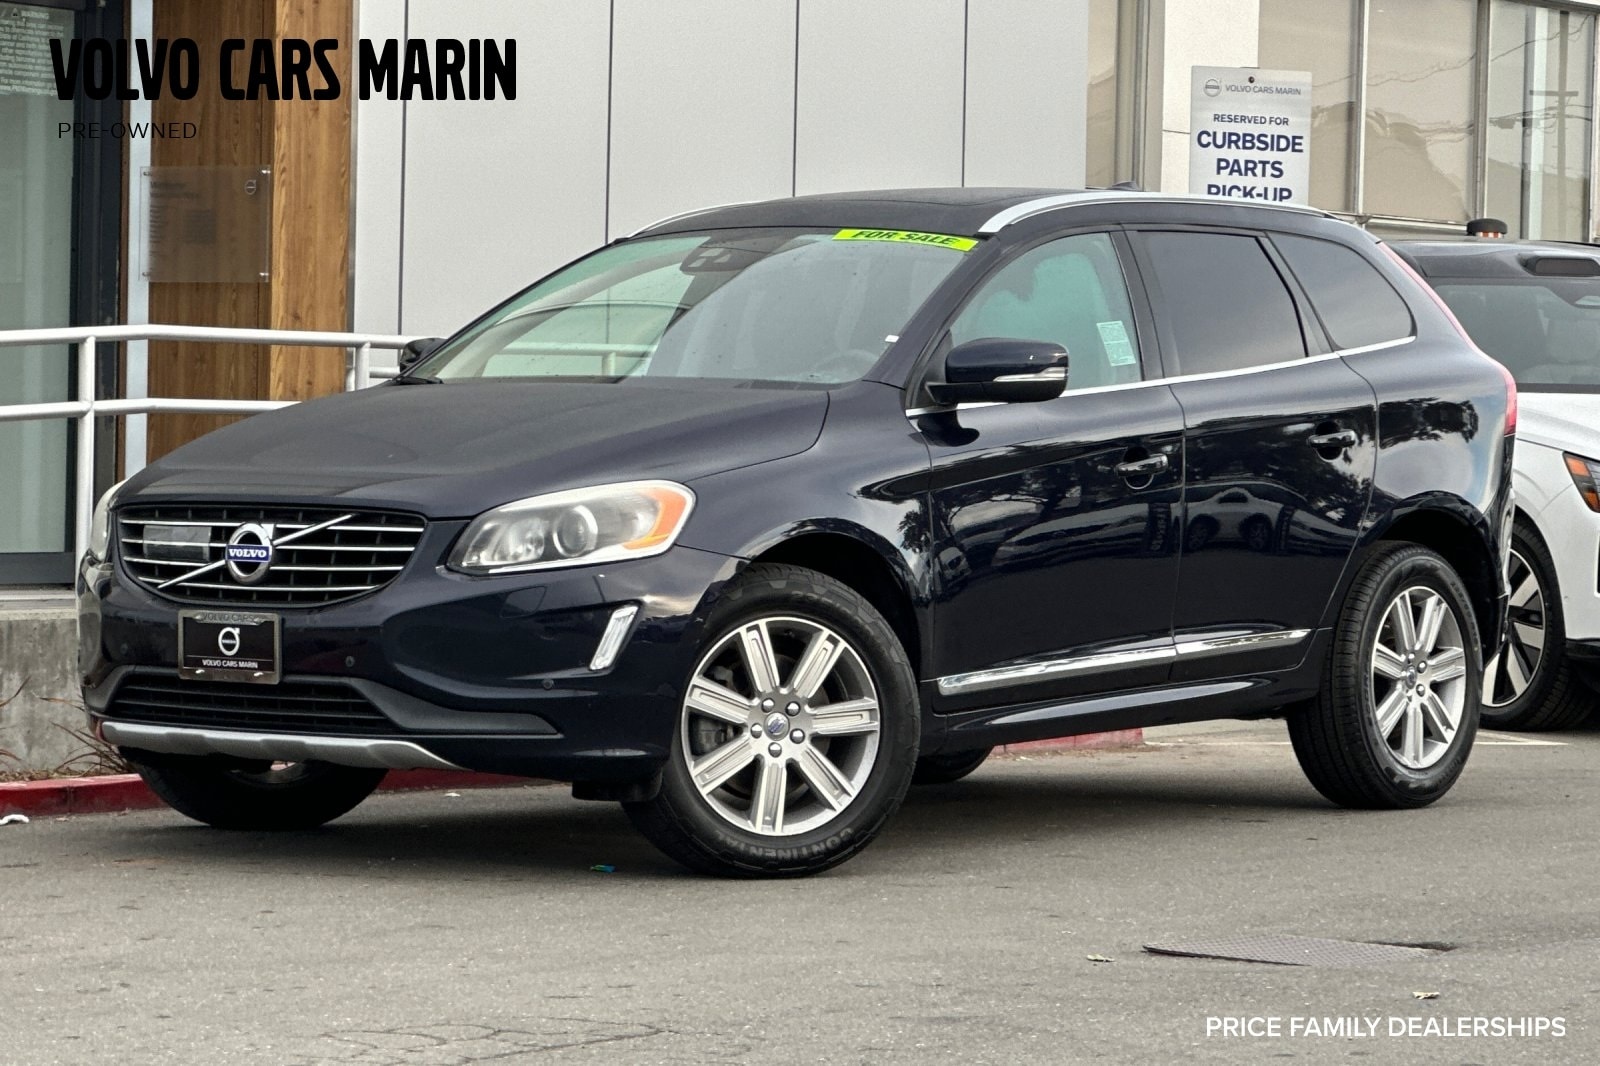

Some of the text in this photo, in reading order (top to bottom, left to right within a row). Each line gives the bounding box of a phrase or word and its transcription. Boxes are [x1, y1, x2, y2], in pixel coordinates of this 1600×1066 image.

[1225, 84, 1251, 93] VOLVO
[1252, 86, 1274, 94] CARS
[1275, 87, 1301, 95] MARIN
[1213, 114, 1289, 126] RESERVED FOR
[1197, 130, 1304, 153] CURBSIDE
[1216, 158, 1284, 179] PARTS
[1207, 184, 1292, 202] PICK-UP
[851, 230, 956, 245] FOR SALE
[228, 548, 267, 558] VOLVO
[203, 611, 230, 622] VOLVO
[202, 659, 221, 667] VOLVO
[239, 661, 258, 669] MARIN
